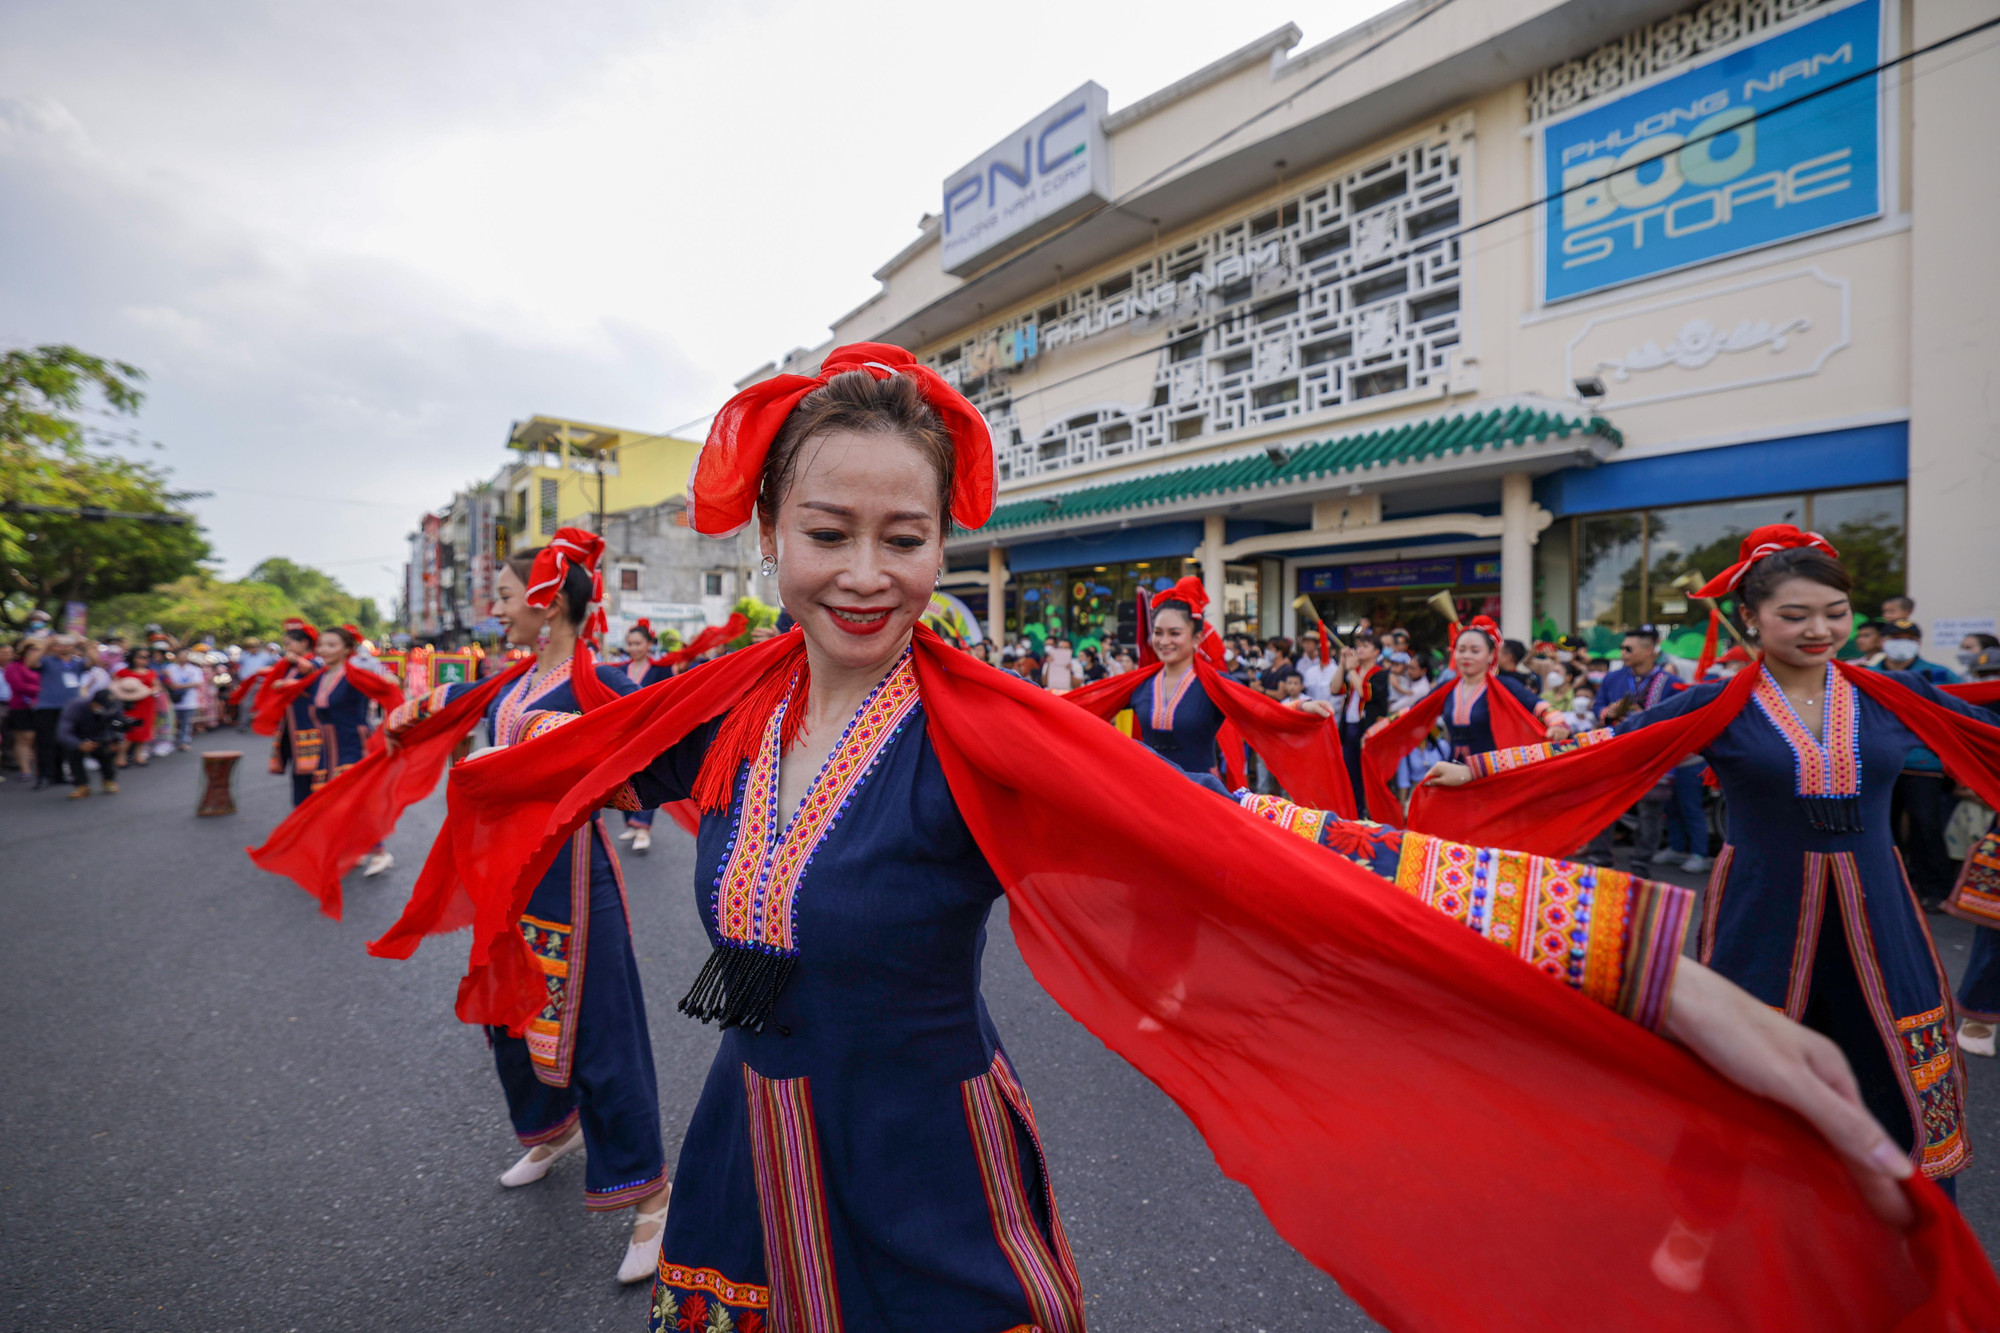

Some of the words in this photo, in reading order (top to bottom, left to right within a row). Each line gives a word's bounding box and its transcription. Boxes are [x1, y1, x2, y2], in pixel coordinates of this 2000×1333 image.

[1562, 89, 1730, 166] PHUONG
[1744, 42, 1853, 100] NAM
[943, 101, 1087, 235] PNC
[1562, 147, 1852, 269] STORE
[1045, 281, 1178, 350] PHUONG
[1188, 240, 1281, 298] NAM
